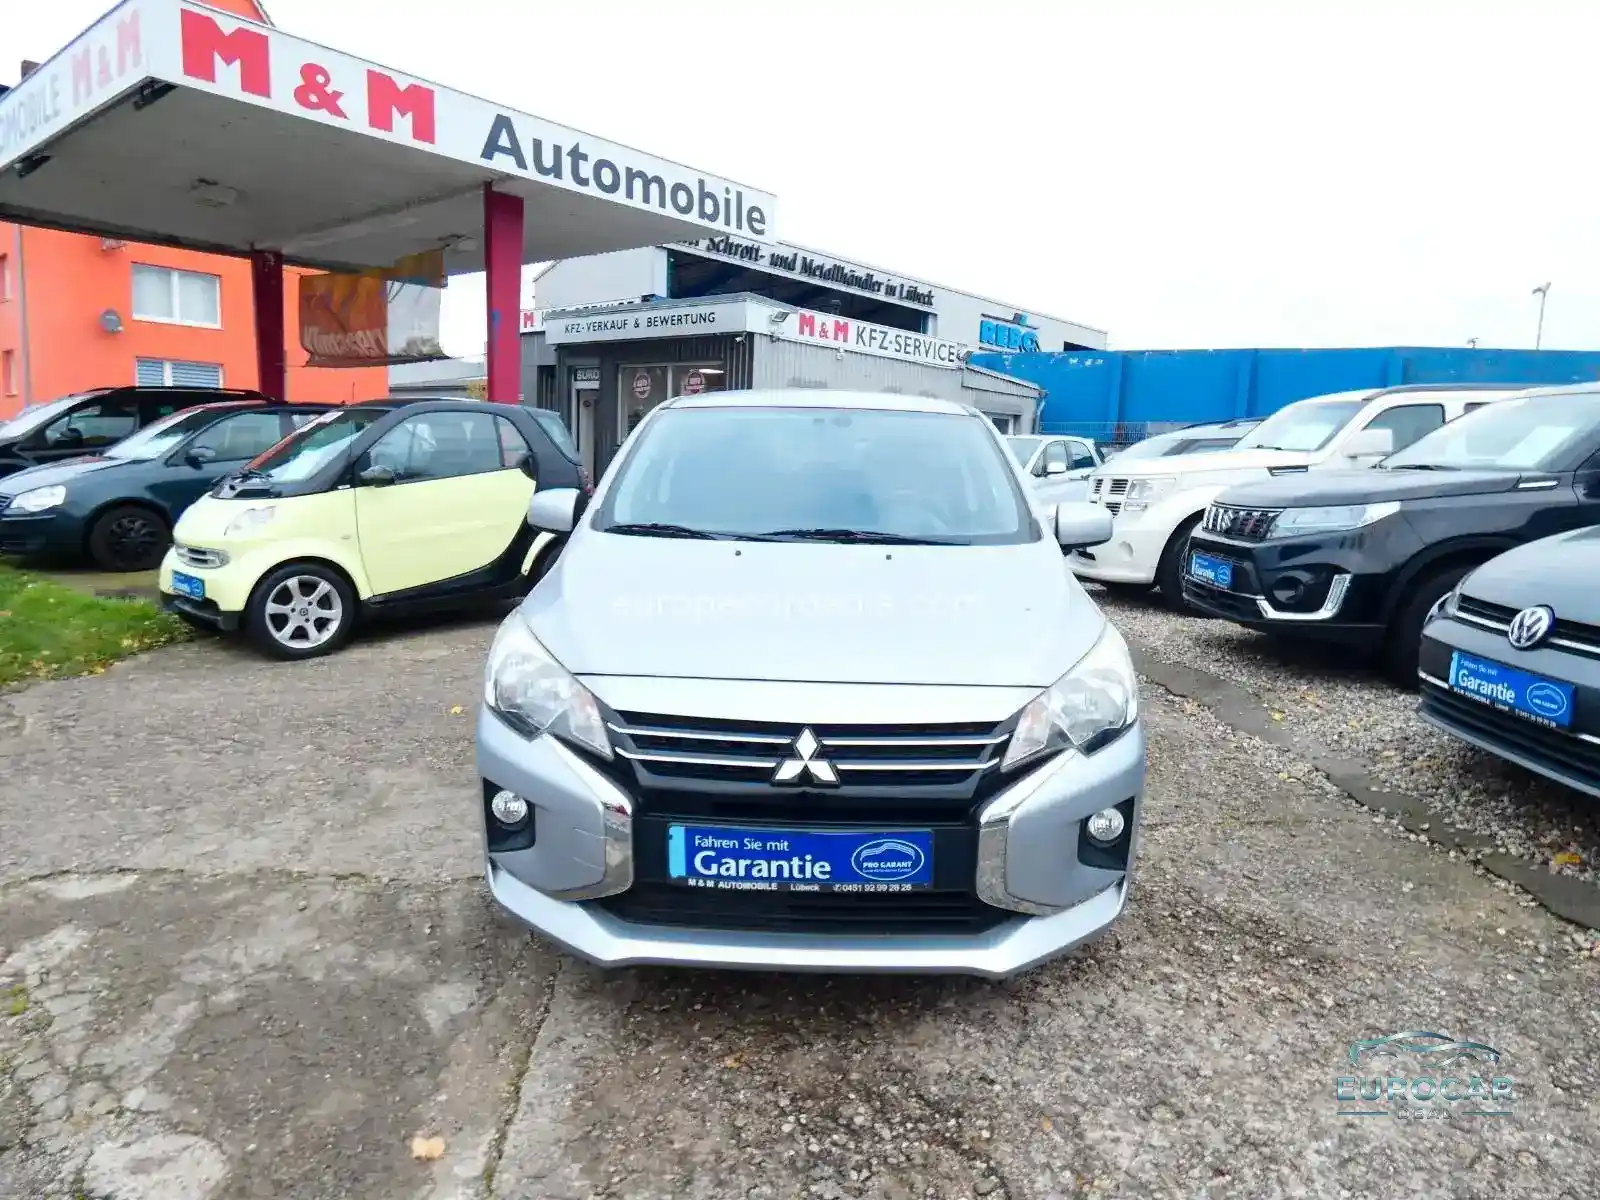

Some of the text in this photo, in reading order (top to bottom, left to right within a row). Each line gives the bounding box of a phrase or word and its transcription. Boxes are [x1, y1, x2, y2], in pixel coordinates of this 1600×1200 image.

[70, 43, 93, 108] M
[97, 44, 113, 89] &
[116, 8, 142, 78] M
[180, 8, 767, 236] M & M Automobile
[769, 252, 797, 272] und
[800, 256, 883, 293] Metallhändler
[884, 279, 897, 297] in
[564, 319, 628, 334] KFZ-VERKAUF
[633, 318, 641, 329] &
[646, 312, 716, 328] BEWERTUNG
[798, 311, 815, 338] M
[818, 322, 829, 339] &
[833, 320, 849, 343] M
[1458, 669, 1516, 703] Garantie
[694, 836, 790, 851] Fahren Sie mit
[693, 850, 832, 880] Garantie
[862, 861, 912, 869] PRO GARANT
[687, 877, 696, 886] M
[697, 879, 705, 887] &
[706, 879, 714, 888] M
[717, 880, 778, 891] AUTOMOBILE
[790, 883, 820, 892] Lübeck
